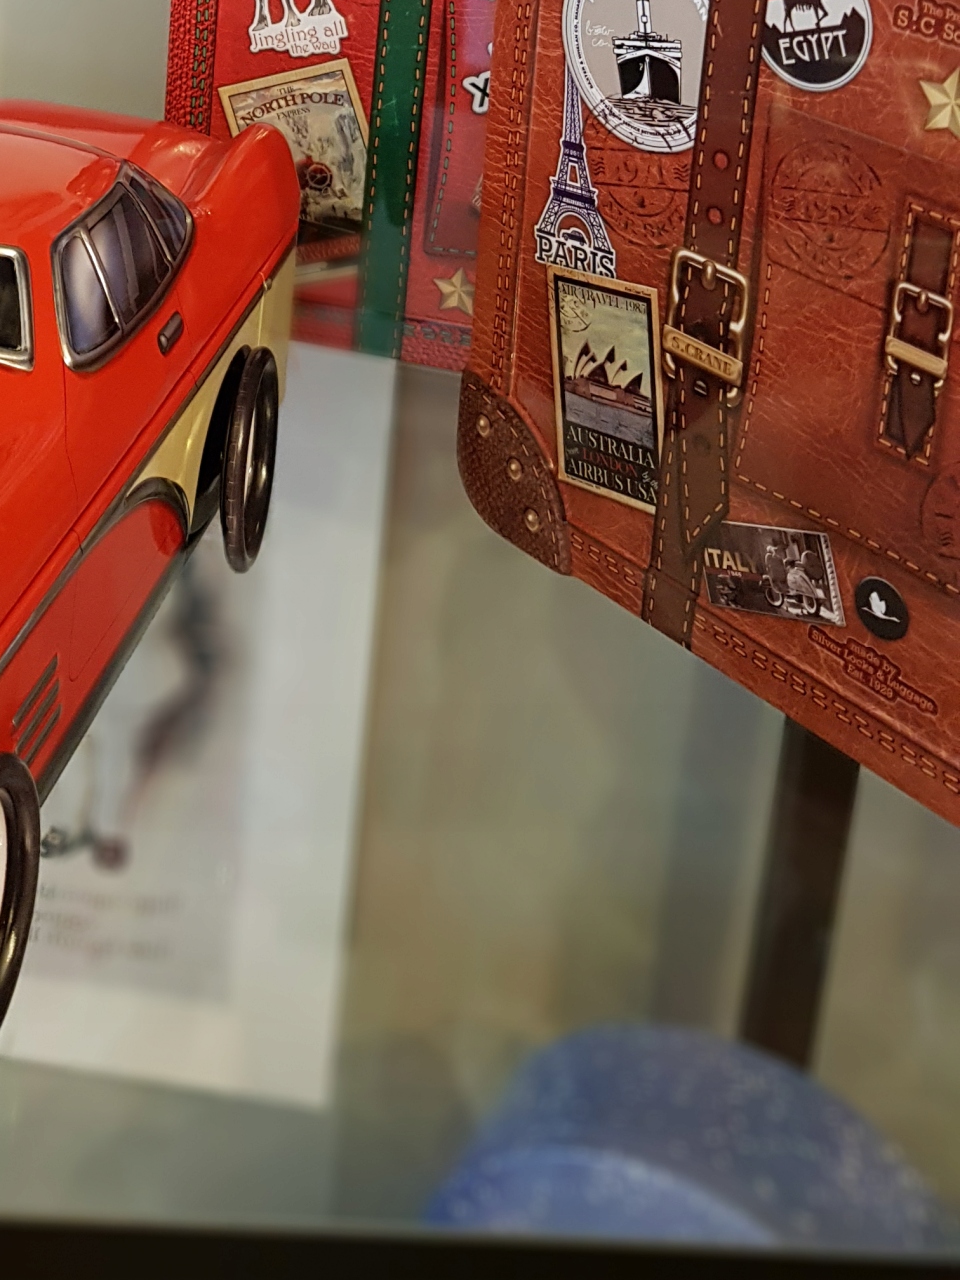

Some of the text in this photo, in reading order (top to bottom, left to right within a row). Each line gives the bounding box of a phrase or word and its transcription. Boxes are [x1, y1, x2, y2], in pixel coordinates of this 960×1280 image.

[252, 20, 345, 50] Jingling all
[291, 40, 337, 54] the way
[778, 30, 846, 65] EGYPT
[240, 92, 344, 126] NORTH POLE
[276, 108, 310, 120] EXPRESS
[537, 234, 615, 279] PARIS
[671, 336, 732, 376] S.CRANE
[567, 425, 655, 469] AUSTRALIA
[583, 448, 637, 477] LONDON
[567, 458, 623, 491] AIRBUS
[627, 478, 657, 503] USA
[704, 548, 757, 573] ITALY
[812, 630, 934, 710] Silver Locks & Luggage
[851, 642, 897, 677] made by
